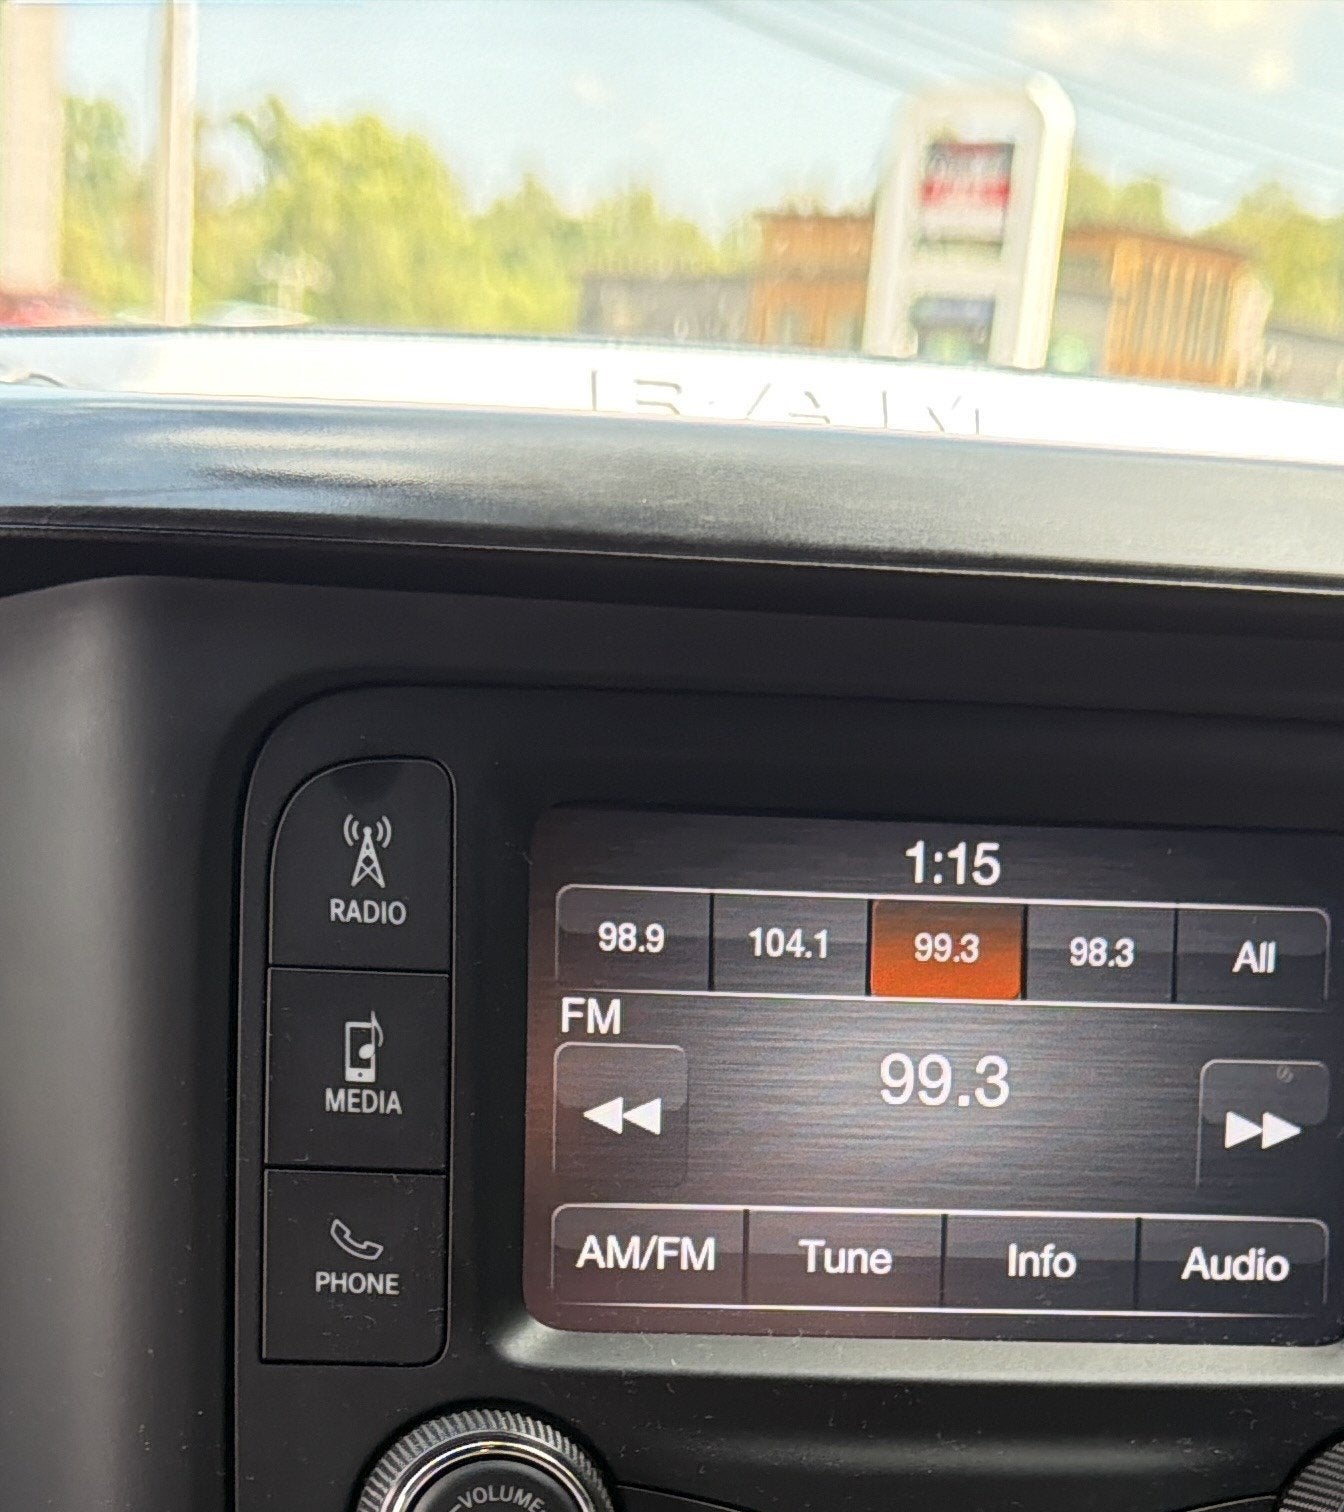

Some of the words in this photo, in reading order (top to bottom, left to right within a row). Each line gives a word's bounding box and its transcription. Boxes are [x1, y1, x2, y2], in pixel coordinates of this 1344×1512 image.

[905, 840, 1001, 886] 1:15
[329, 897, 407, 926] RADIO
[598, 921, 665, 954] 98.9
[748, 926, 828, 959] 104.1
[914, 932, 980, 964] 99.3
[1068, 936, 1135, 968] 98.3
[1232, 939, 1276, 974] All
[561, 996, 621, 1035] FM
[325, 1087, 403, 1115] MEDIA
[878, 1052, 1010, 1108] 99.3
[575, 1233, 717, 1272] AM/FM
[797, 1237, 893, 1275] Tune
[1007, 1242, 1078, 1278] Info
[1180, 1246, 1290, 1283] Audio
[315, 1270, 400, 1295] PHONE
